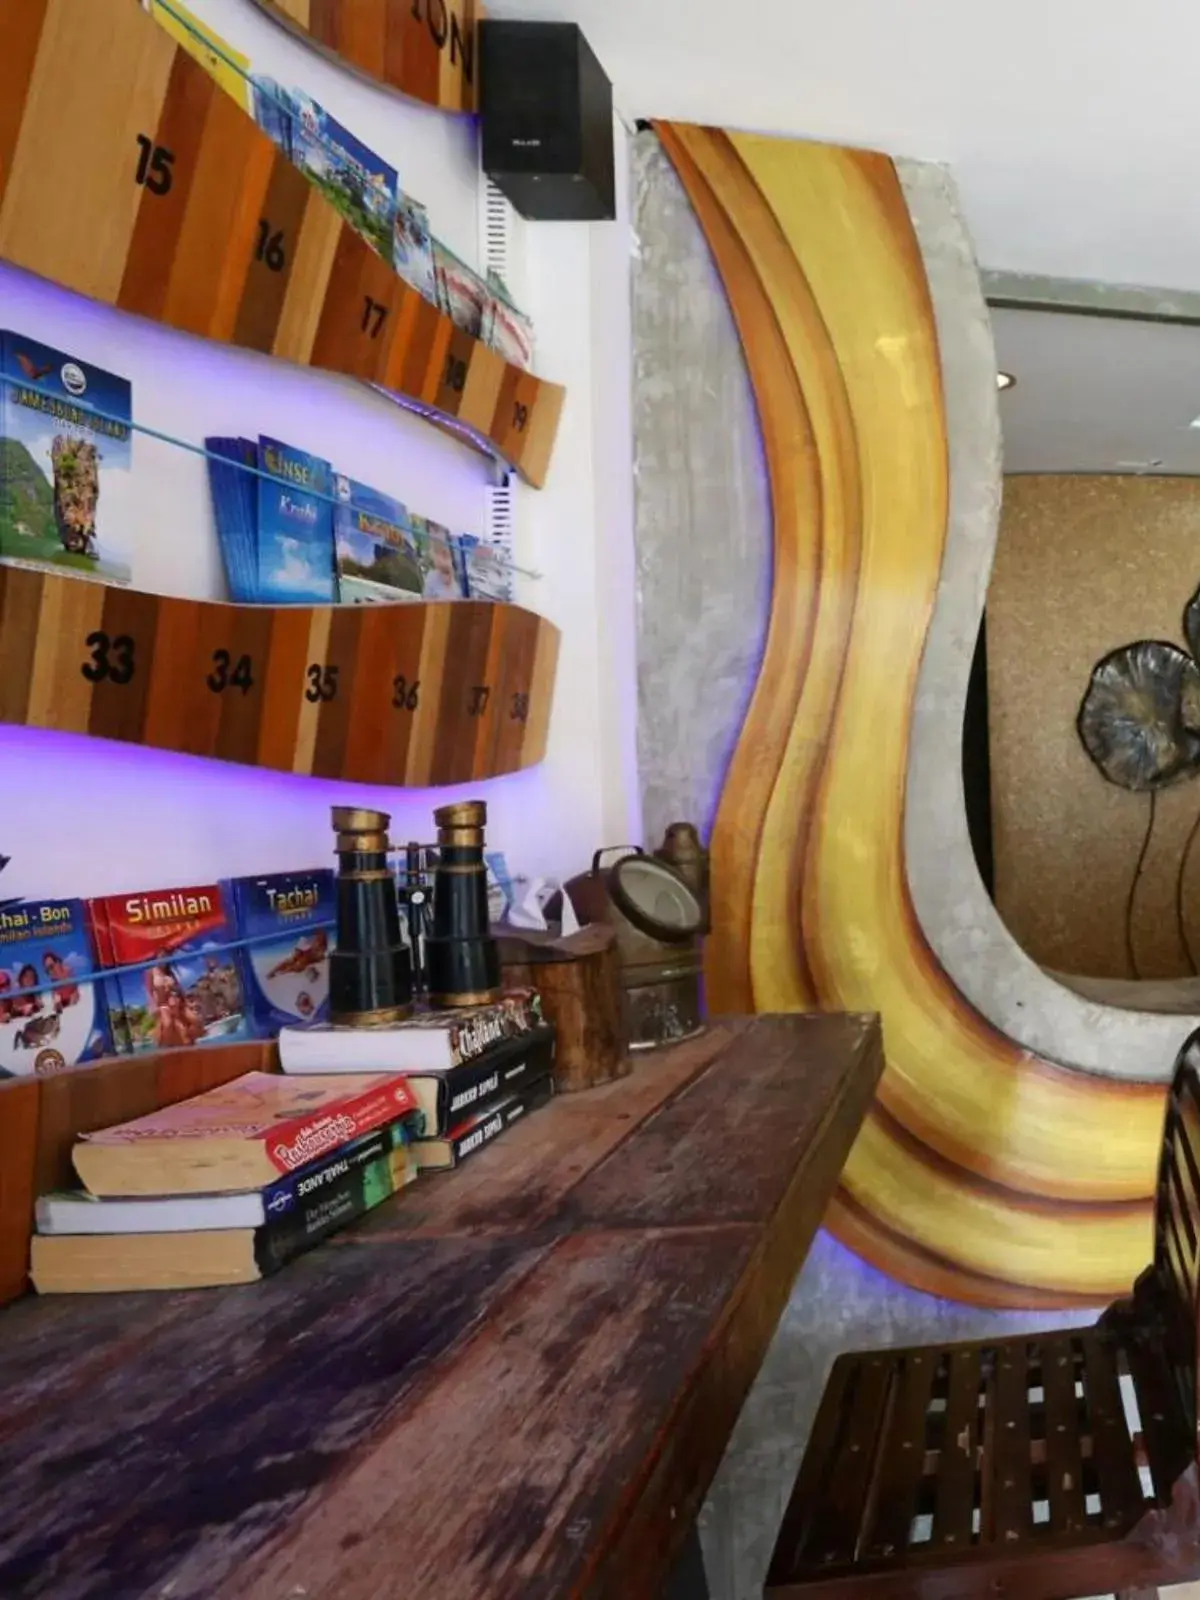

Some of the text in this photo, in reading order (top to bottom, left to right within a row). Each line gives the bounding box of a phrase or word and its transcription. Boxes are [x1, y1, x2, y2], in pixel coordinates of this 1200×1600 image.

[136, 133, 175, 196] 15
[257, 218, 285, 272] 16
[361, 295, 387, 340] 17
[445, 354, 467, 392] 18
[513, 401, 528, 433] 19
[81, 630, 135, 684] 33
[206, 648, 254, 696] 34
[305, 663, 339, 702] 35
[391, 674, 420, 711] 36
[467, 685, 490, 717] 37
[0, 909, 28, 928] hai
[40, 905, 70, 922] Bon
[126, 892, 213, 923] Similan
[266, 884, 319, 912] Tachai
